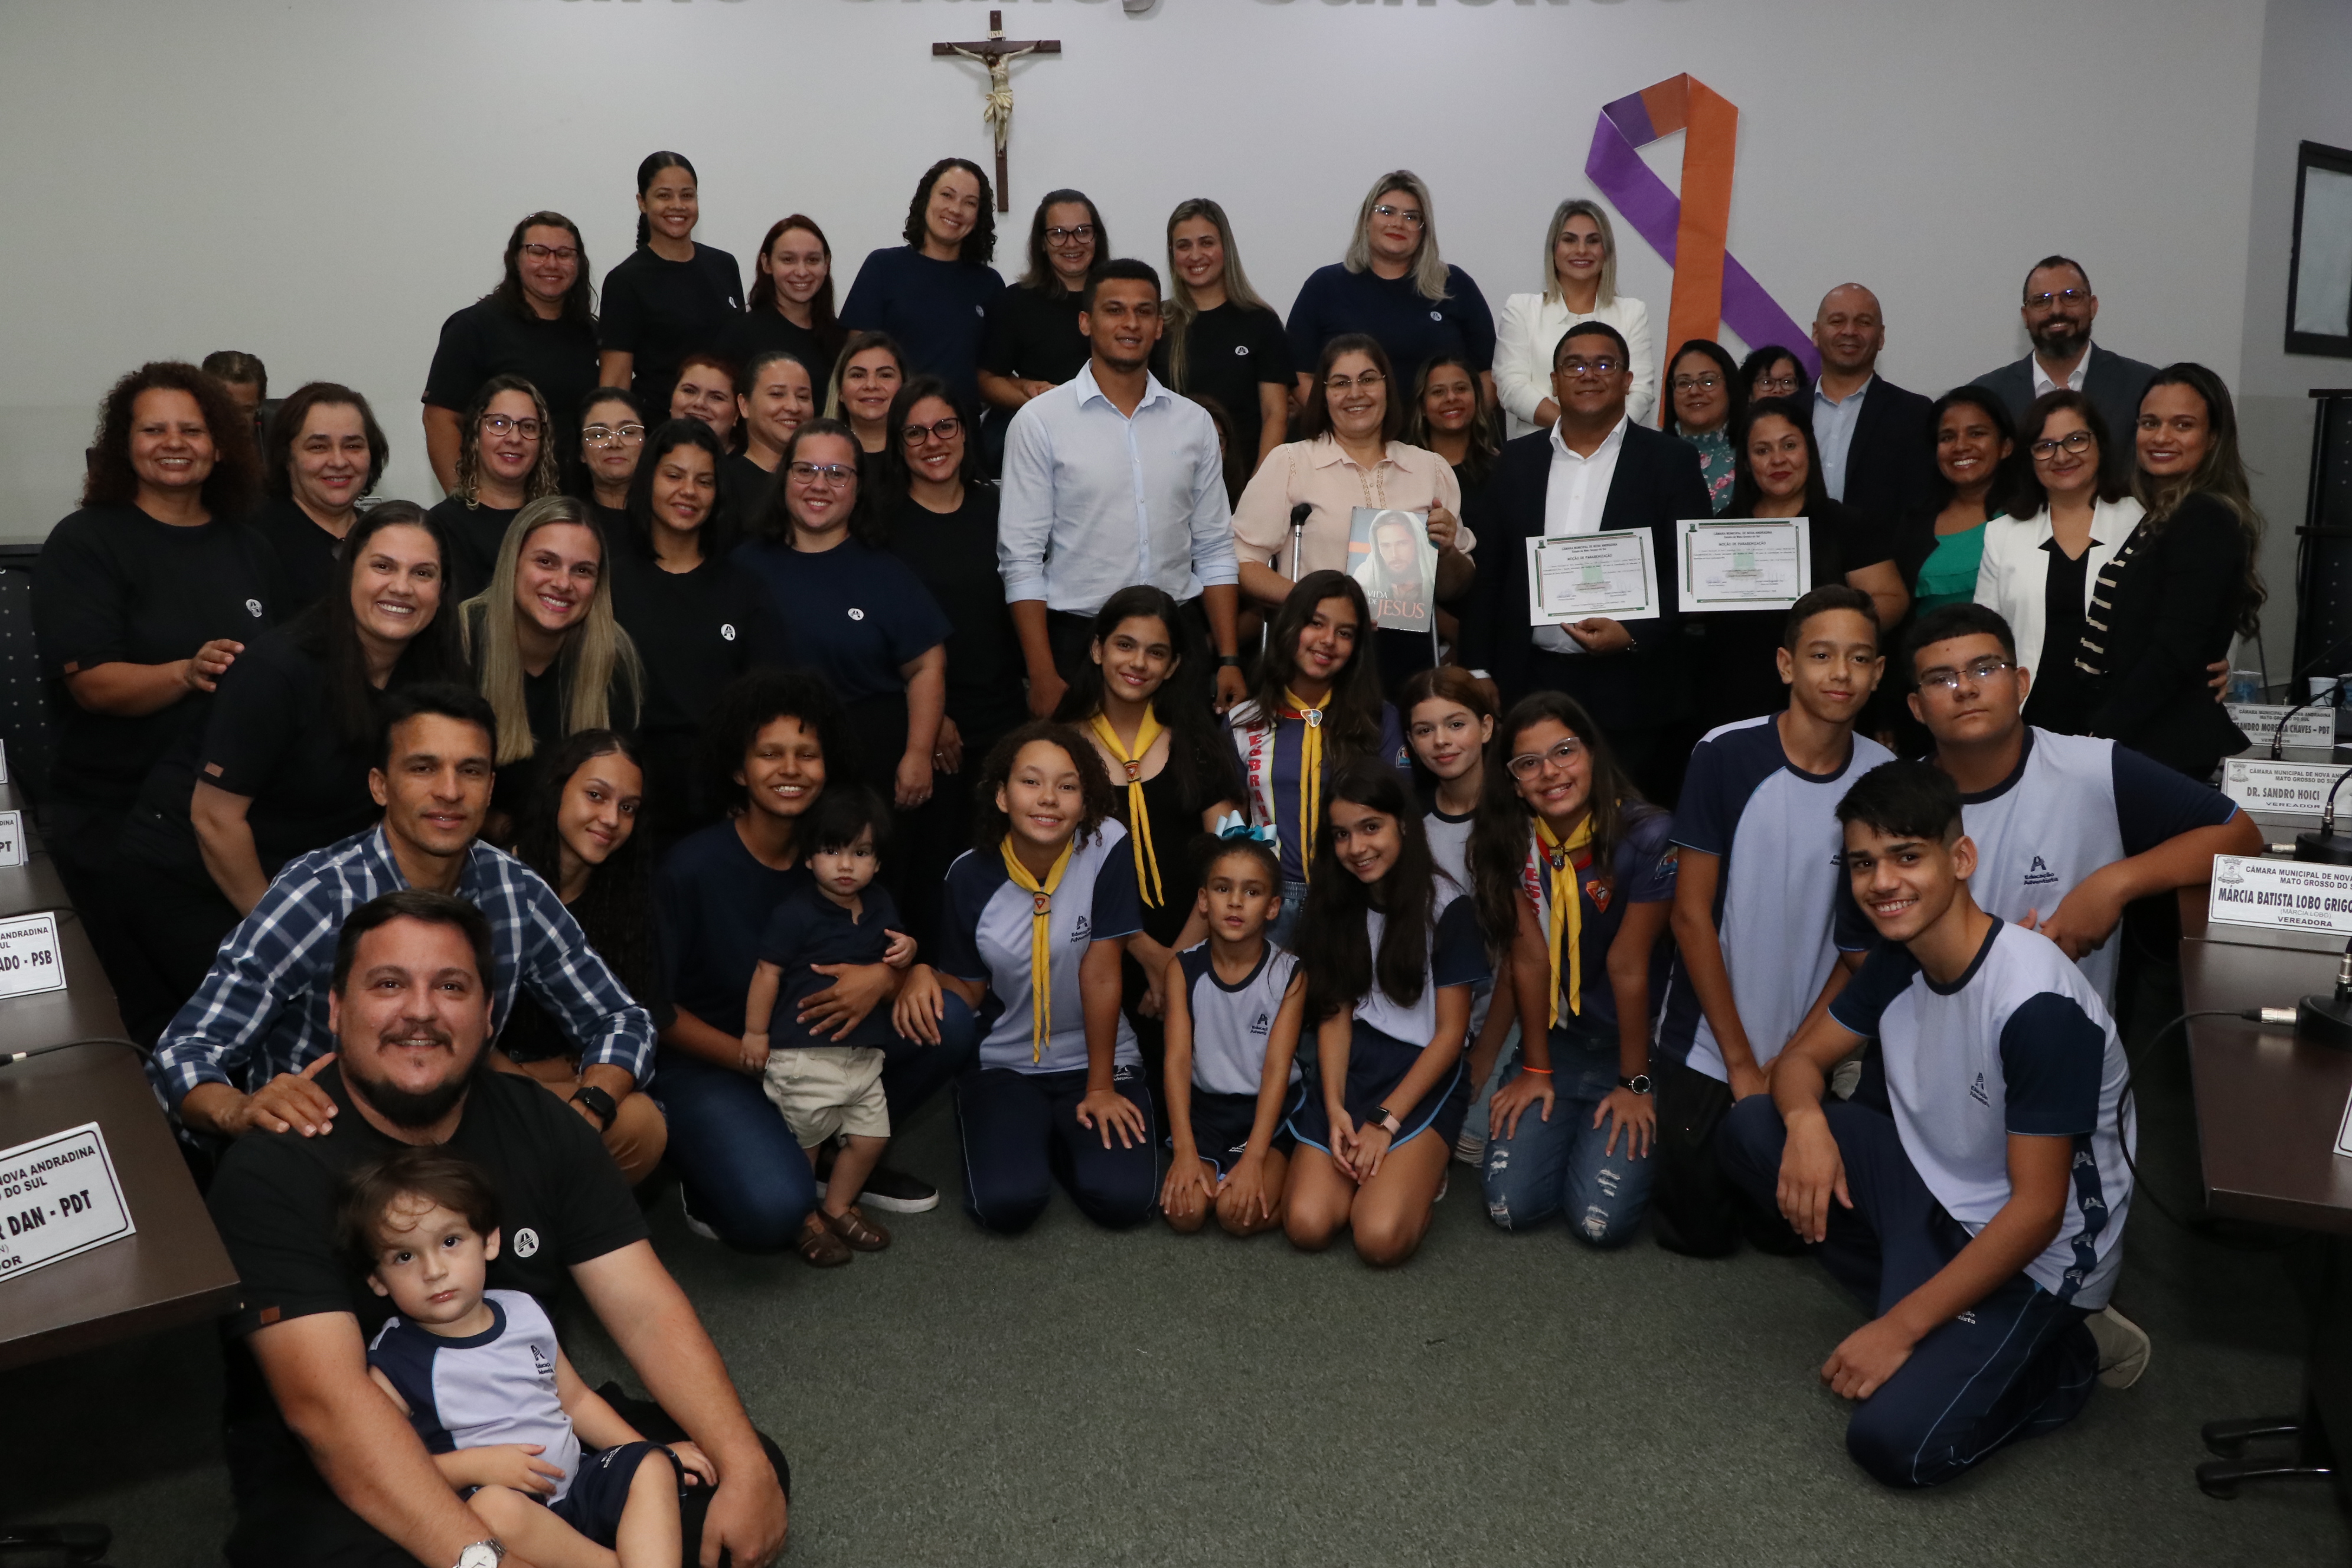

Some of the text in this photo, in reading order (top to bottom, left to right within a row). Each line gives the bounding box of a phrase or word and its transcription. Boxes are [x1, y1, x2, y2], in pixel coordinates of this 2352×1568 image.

[1367, 590, 1388, 599] VIDA
[1376, 599, 1425, 619] JESUS
[2290, 724, 2311, 733] CHAVES
[2318, 726, 2330, 734] PDT
[2247, 786, 2320, 801] DR. SANDRO HOICI
[2246, 865, 2276, 876] CÂMARA
[2279, 869, 2319, 879] MUNICIPAL
[2304, 879, 2334, 888] GROSSO
[2218, 884, 2253, 904] MÁRCIA
[2257, 891, 2293, 907] BATISTA
[2296, 895, 2321, 910] LOBO
[2280, 908, 2331, 919] (MÁRCIA LOBO)
[2278, 916, 2333, 927] VEREADORA
[1, 927, 49, 940] ANDRADINA
[31, 950, 53, 966] PSB
[31, 1145, 96, 1175] ANDRADINA
[4, 1184, 21, 1198] DO
[24, 1176, 48, 1191] SUL
[7, 1206, 46, 1236] DAN
[59, 1190, 92, 1217] PDT
